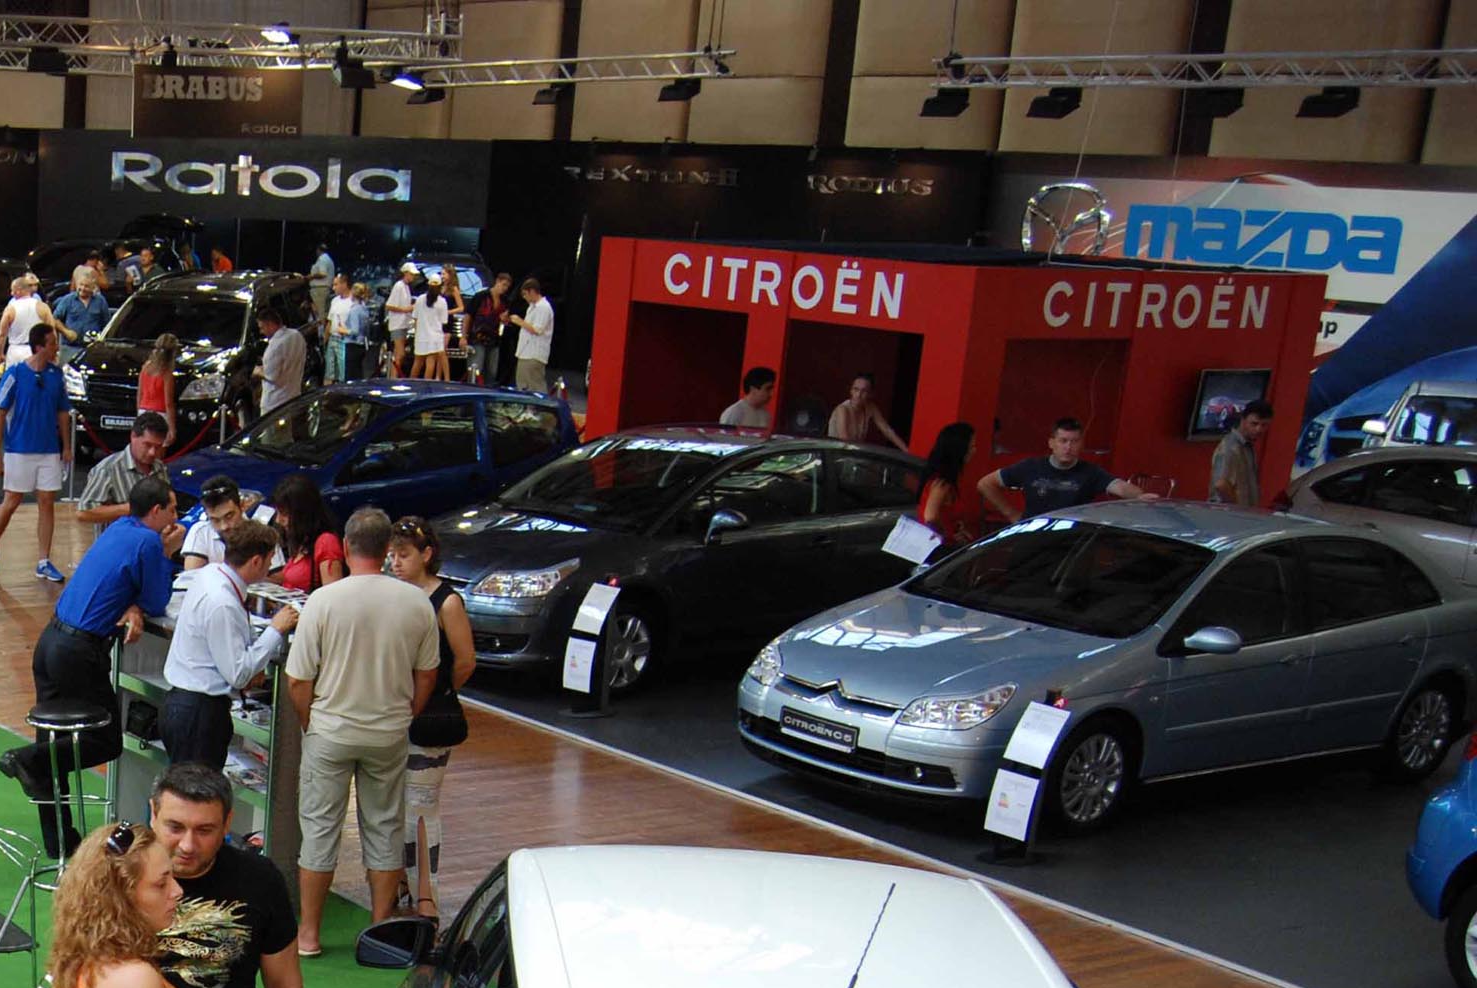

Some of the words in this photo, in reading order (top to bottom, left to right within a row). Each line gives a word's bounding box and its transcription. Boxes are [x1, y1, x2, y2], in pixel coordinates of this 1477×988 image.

[142, 74, 264, 102] BRABUS
[110, 151, 413, 202] Ratola
[663, 252, 905, 320] CITROËN
[1043, 277, 1270, 330] CITROËN
[784, 715, 833, 737] CITROËN
